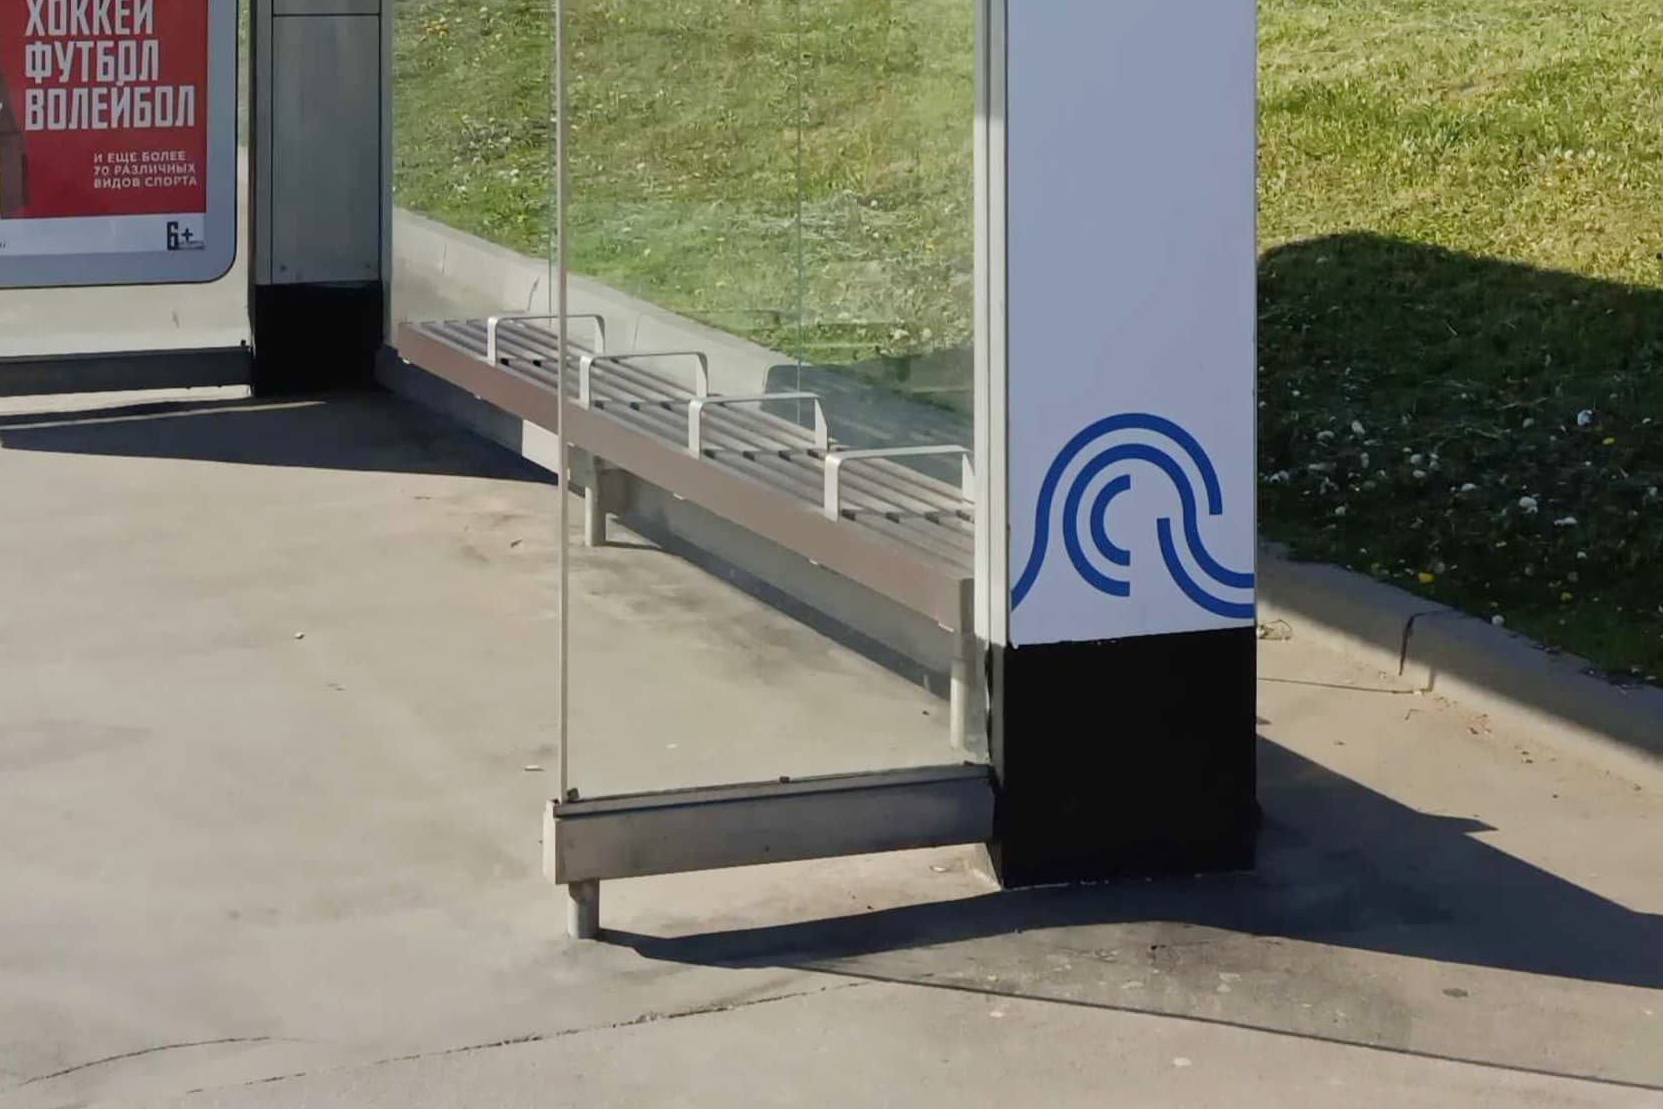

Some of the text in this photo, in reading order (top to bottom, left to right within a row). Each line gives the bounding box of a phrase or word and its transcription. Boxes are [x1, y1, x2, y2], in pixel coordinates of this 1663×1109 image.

[25, 40, 159, 84] ФУТБОЛ
[25, 80, 195, 130] ВОЛЕЙБОЛ
[93, 152, 103, 163] И
[141, 150, 187, 163] БОЛЕЕ
[94, 162, 196, 176] 70 РАЗЛИЧНЫХ
[93, 175, 198, 190] ВИДОВ СПОРТА
[166, 221, 194, 251] 6+
